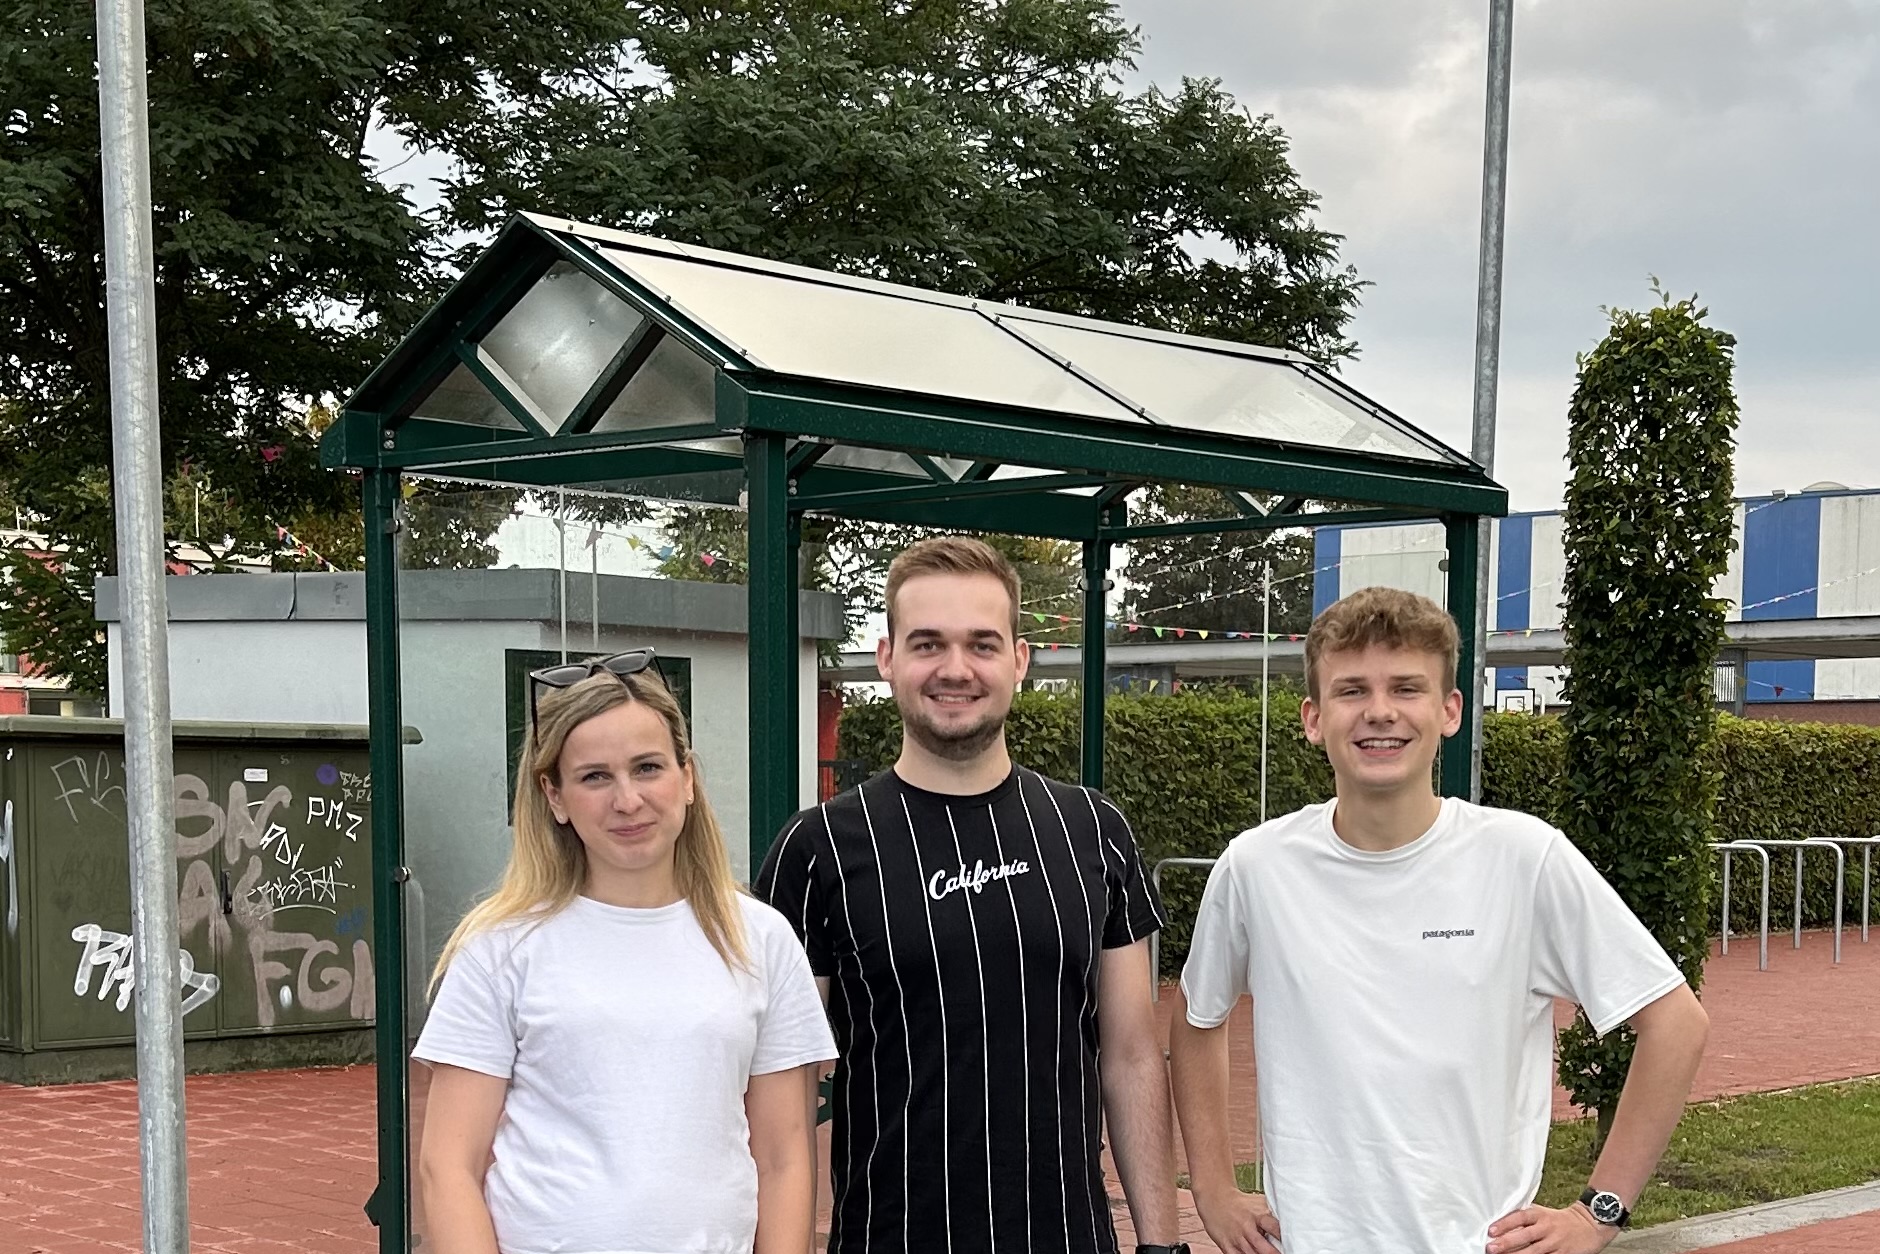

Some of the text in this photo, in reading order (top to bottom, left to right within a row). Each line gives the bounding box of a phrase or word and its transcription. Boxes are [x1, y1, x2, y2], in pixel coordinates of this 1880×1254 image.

[306, 796, 363, 842] PMZ
[928, 859, 1030, 900] California
[1422, 929, 1475, 940] patagonia
